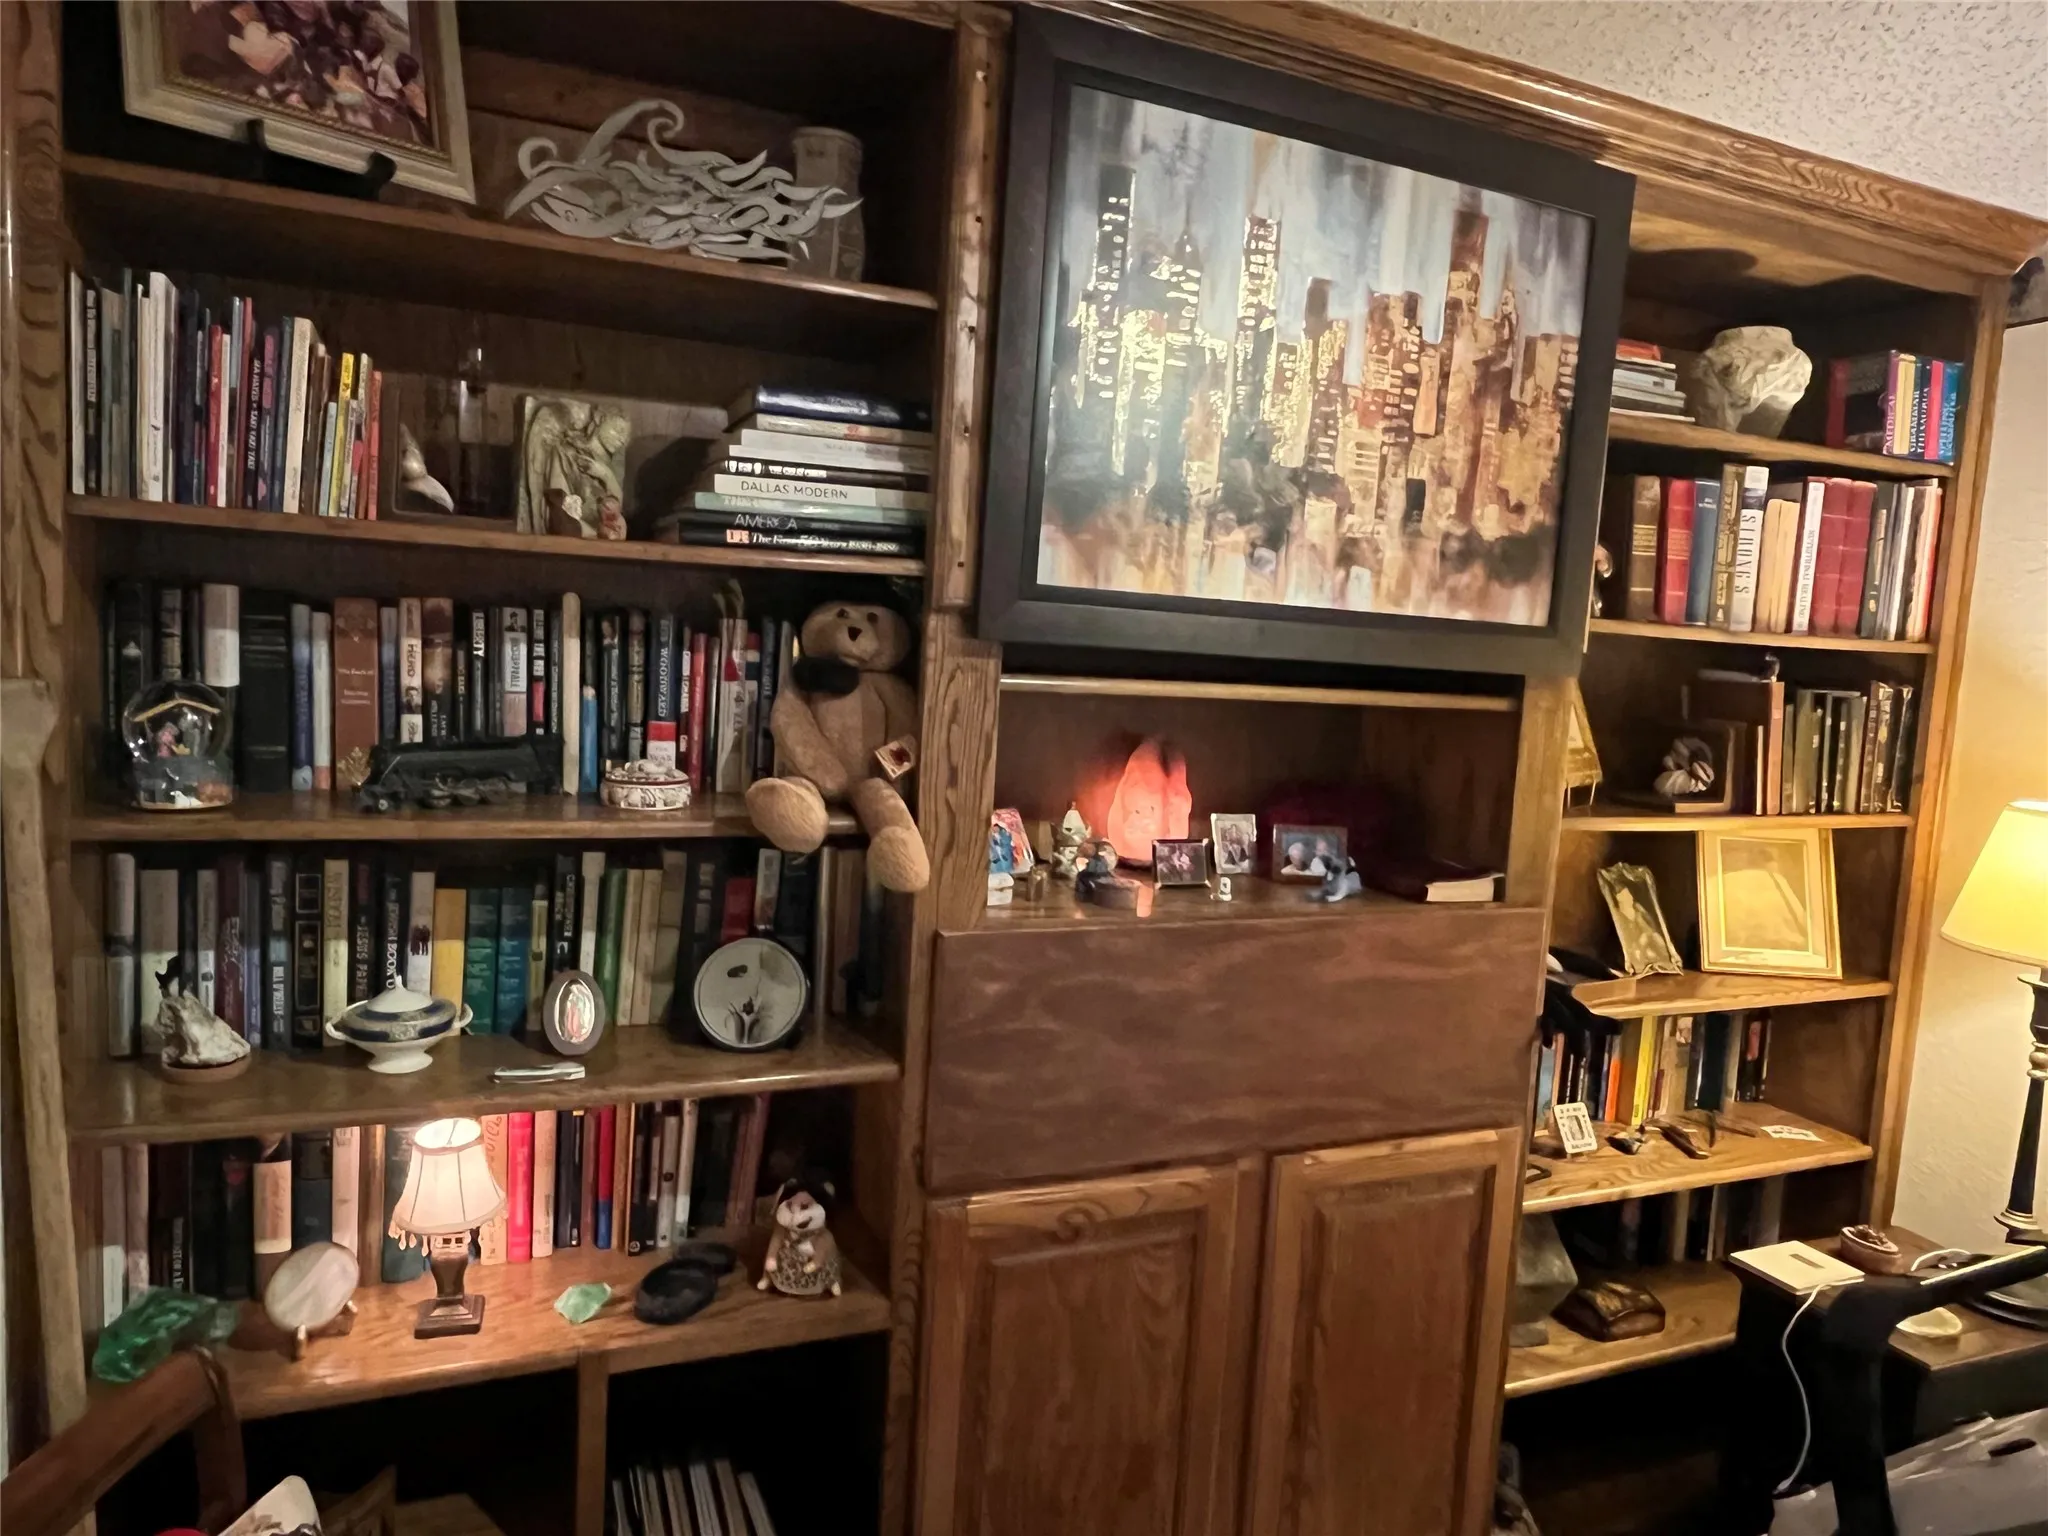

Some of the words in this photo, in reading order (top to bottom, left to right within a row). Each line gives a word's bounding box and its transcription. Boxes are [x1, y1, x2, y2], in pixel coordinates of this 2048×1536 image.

[741, 480, 790, 495] DALLAS
[794, 484, 849, 500] MODERN
[751, 532, 773, 544] The
[1734, 514, 1757, 595] STRONG'S
